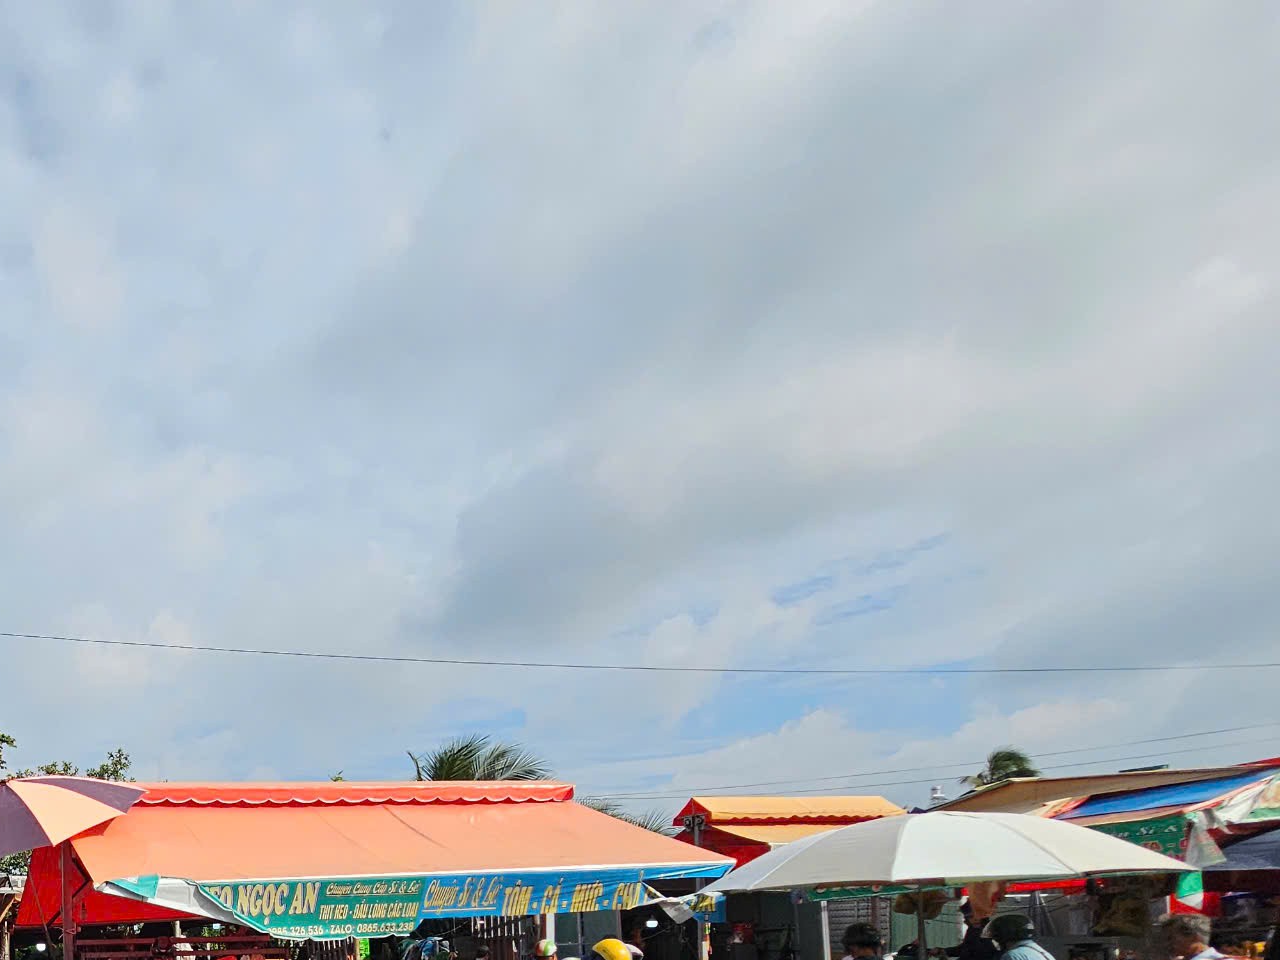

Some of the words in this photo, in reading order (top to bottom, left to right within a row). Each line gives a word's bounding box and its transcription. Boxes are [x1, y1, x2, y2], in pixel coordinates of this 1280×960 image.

[237, 883, 290, 925] NGỌC
[288, 881, 321, 915] AN
[501, 879, 534, 916] TÔM
[540, 877, 565, 914] CÁ
[330, 923, 355, 934] ZALO:
